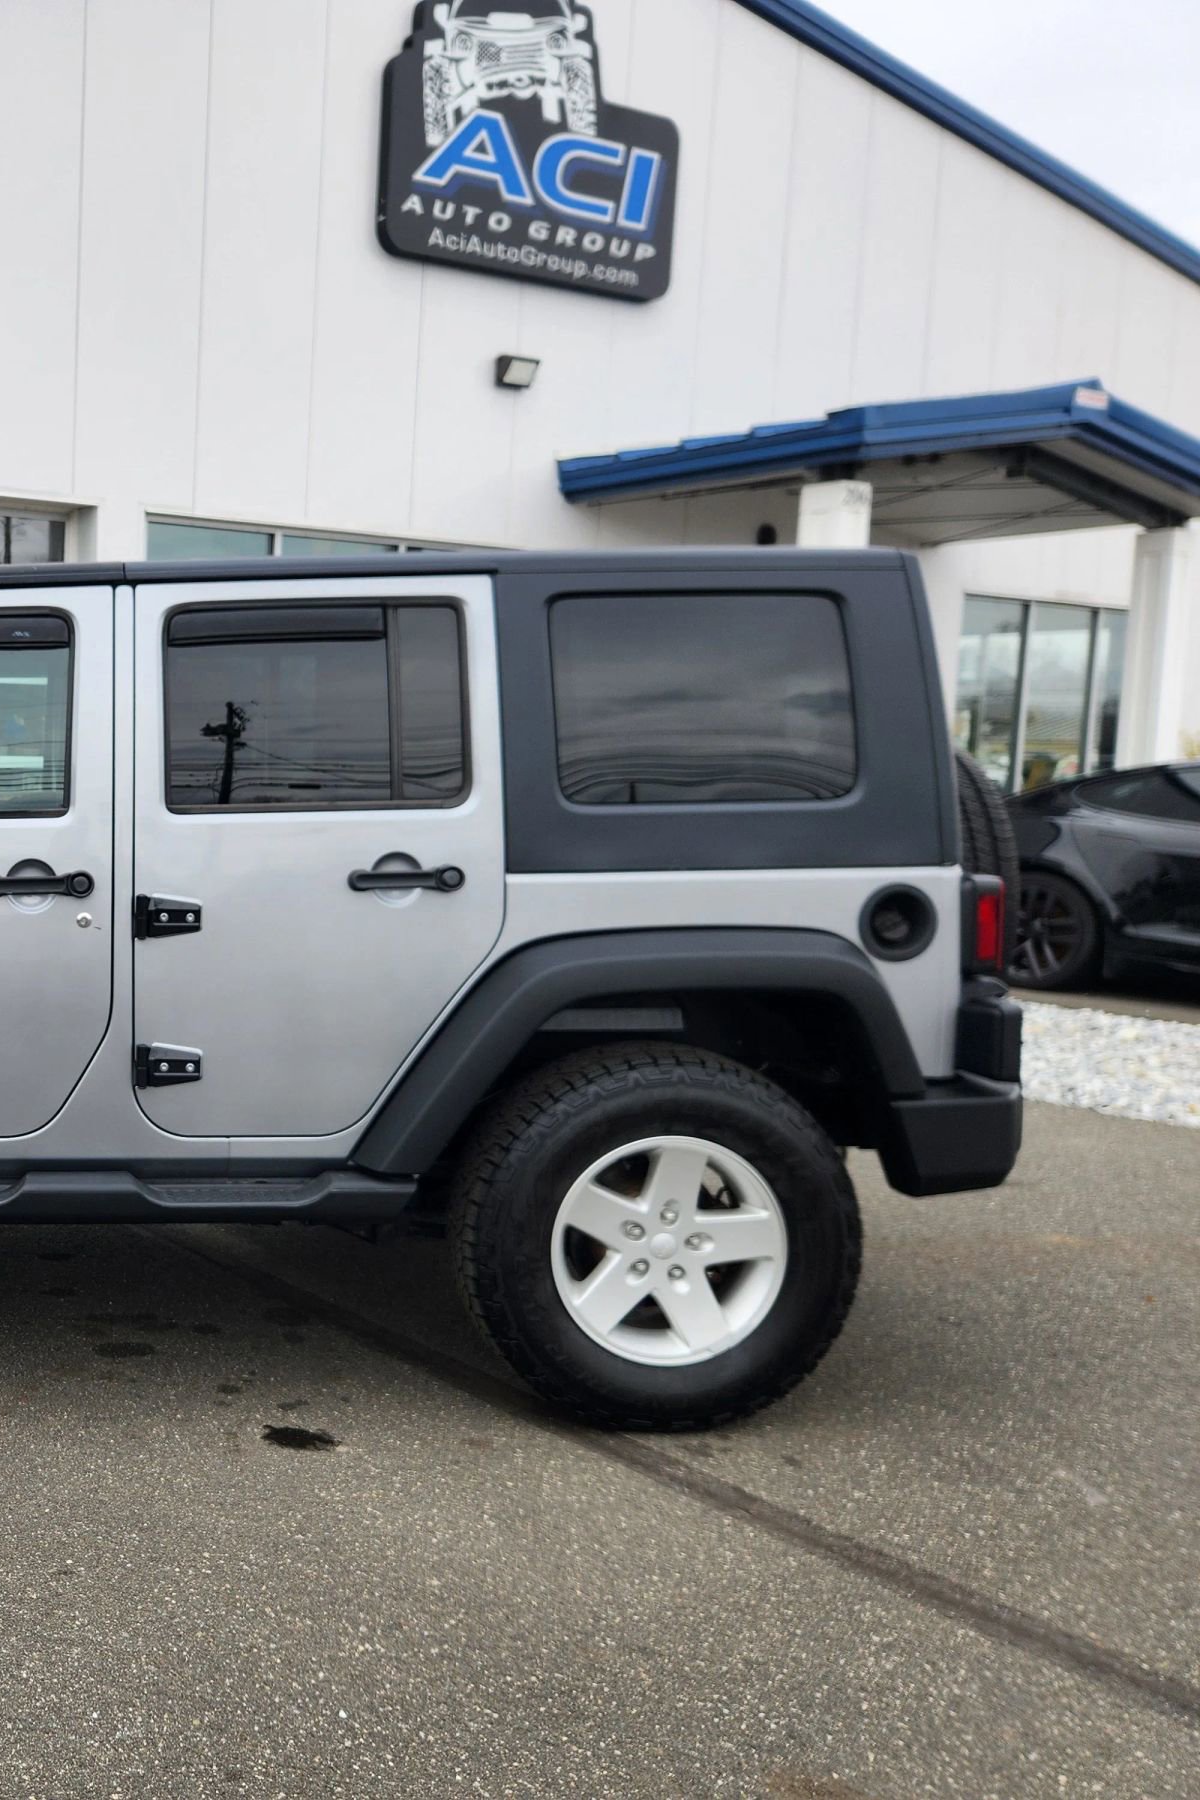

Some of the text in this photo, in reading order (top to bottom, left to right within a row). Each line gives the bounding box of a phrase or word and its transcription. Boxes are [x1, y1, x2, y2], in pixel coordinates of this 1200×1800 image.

[412, 107, 662, 232] ACI
[401, 193, 657, 263] AUTO GROUP
[427, 226, 640, 288] AciAutoGroup.com
